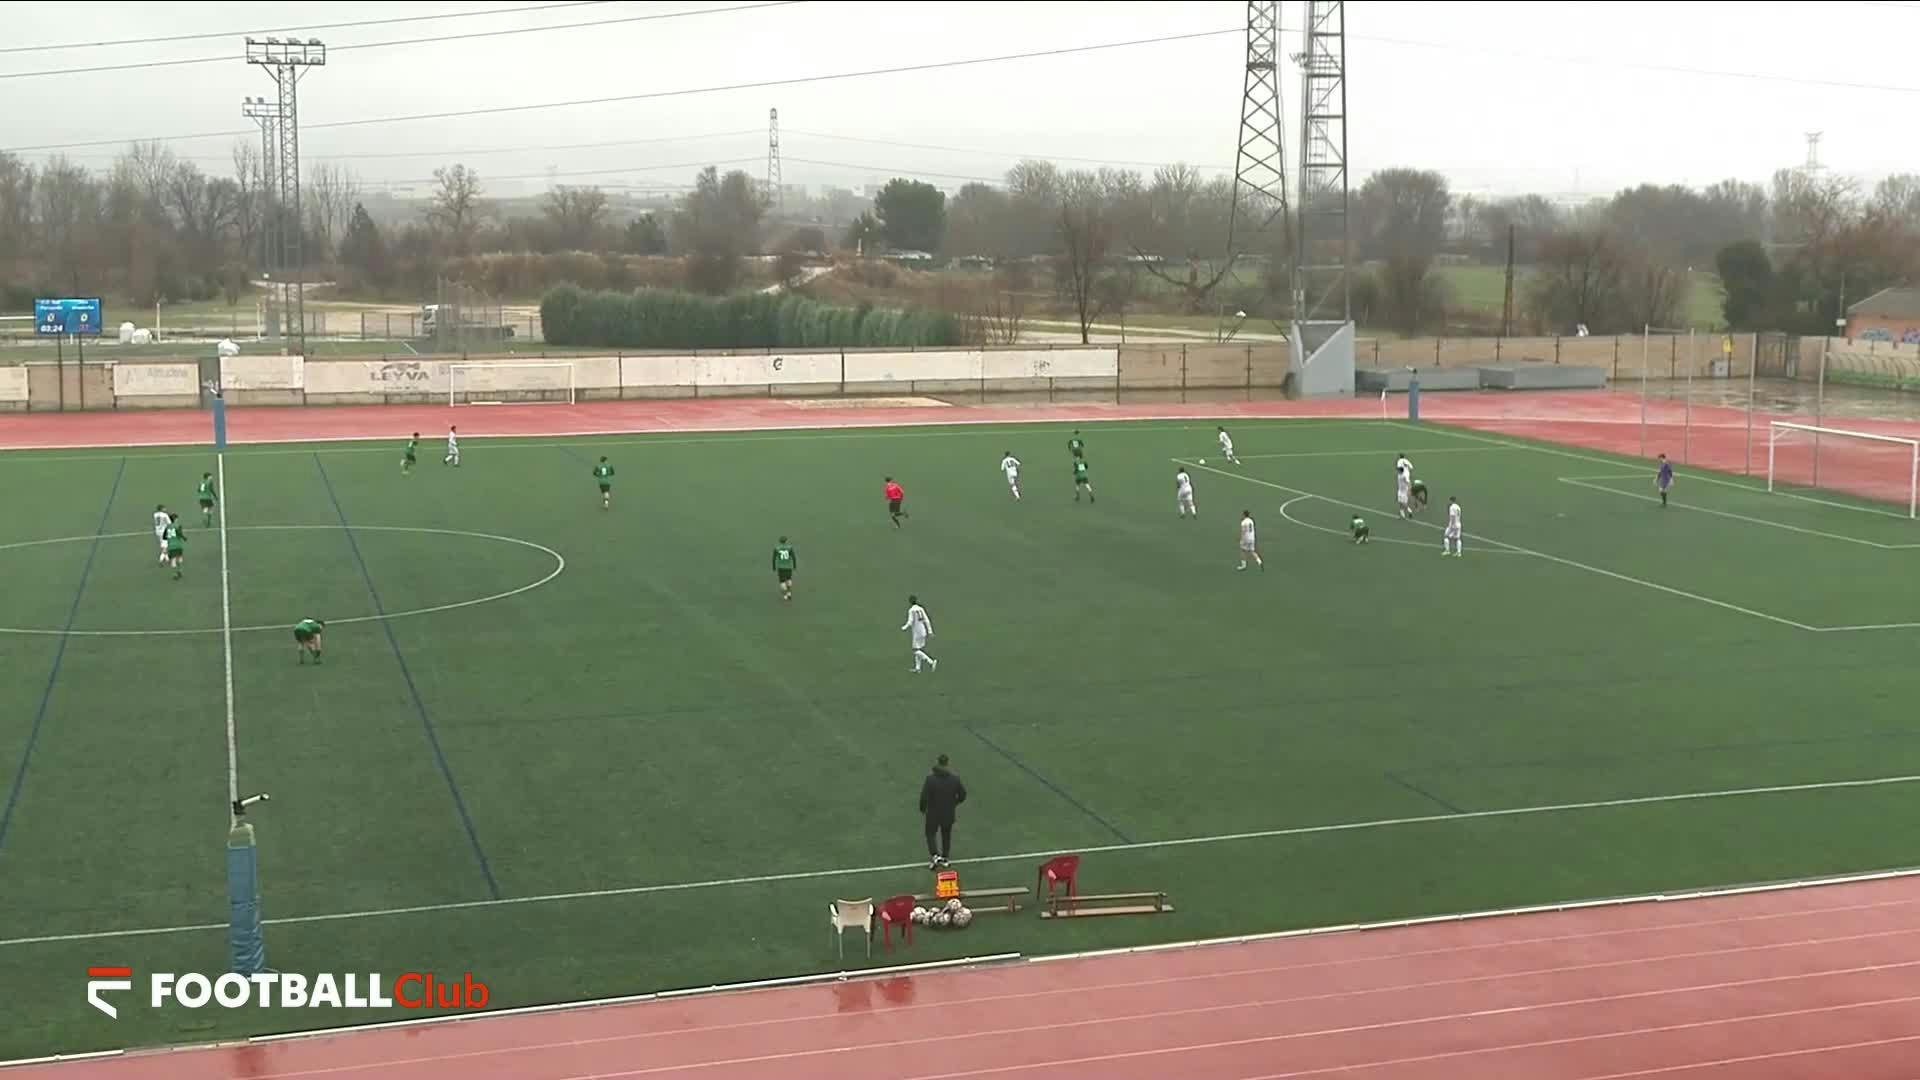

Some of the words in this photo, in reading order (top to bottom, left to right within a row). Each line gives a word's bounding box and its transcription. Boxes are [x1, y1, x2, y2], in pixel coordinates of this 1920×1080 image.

[47, 312, 56, 323] 0
[80, 312, 88, 323] 0
[40, 324, 63, 332] 03:24
[370, 371, 430, 381] LEYVA
[779, 550, 790, 560] 70
